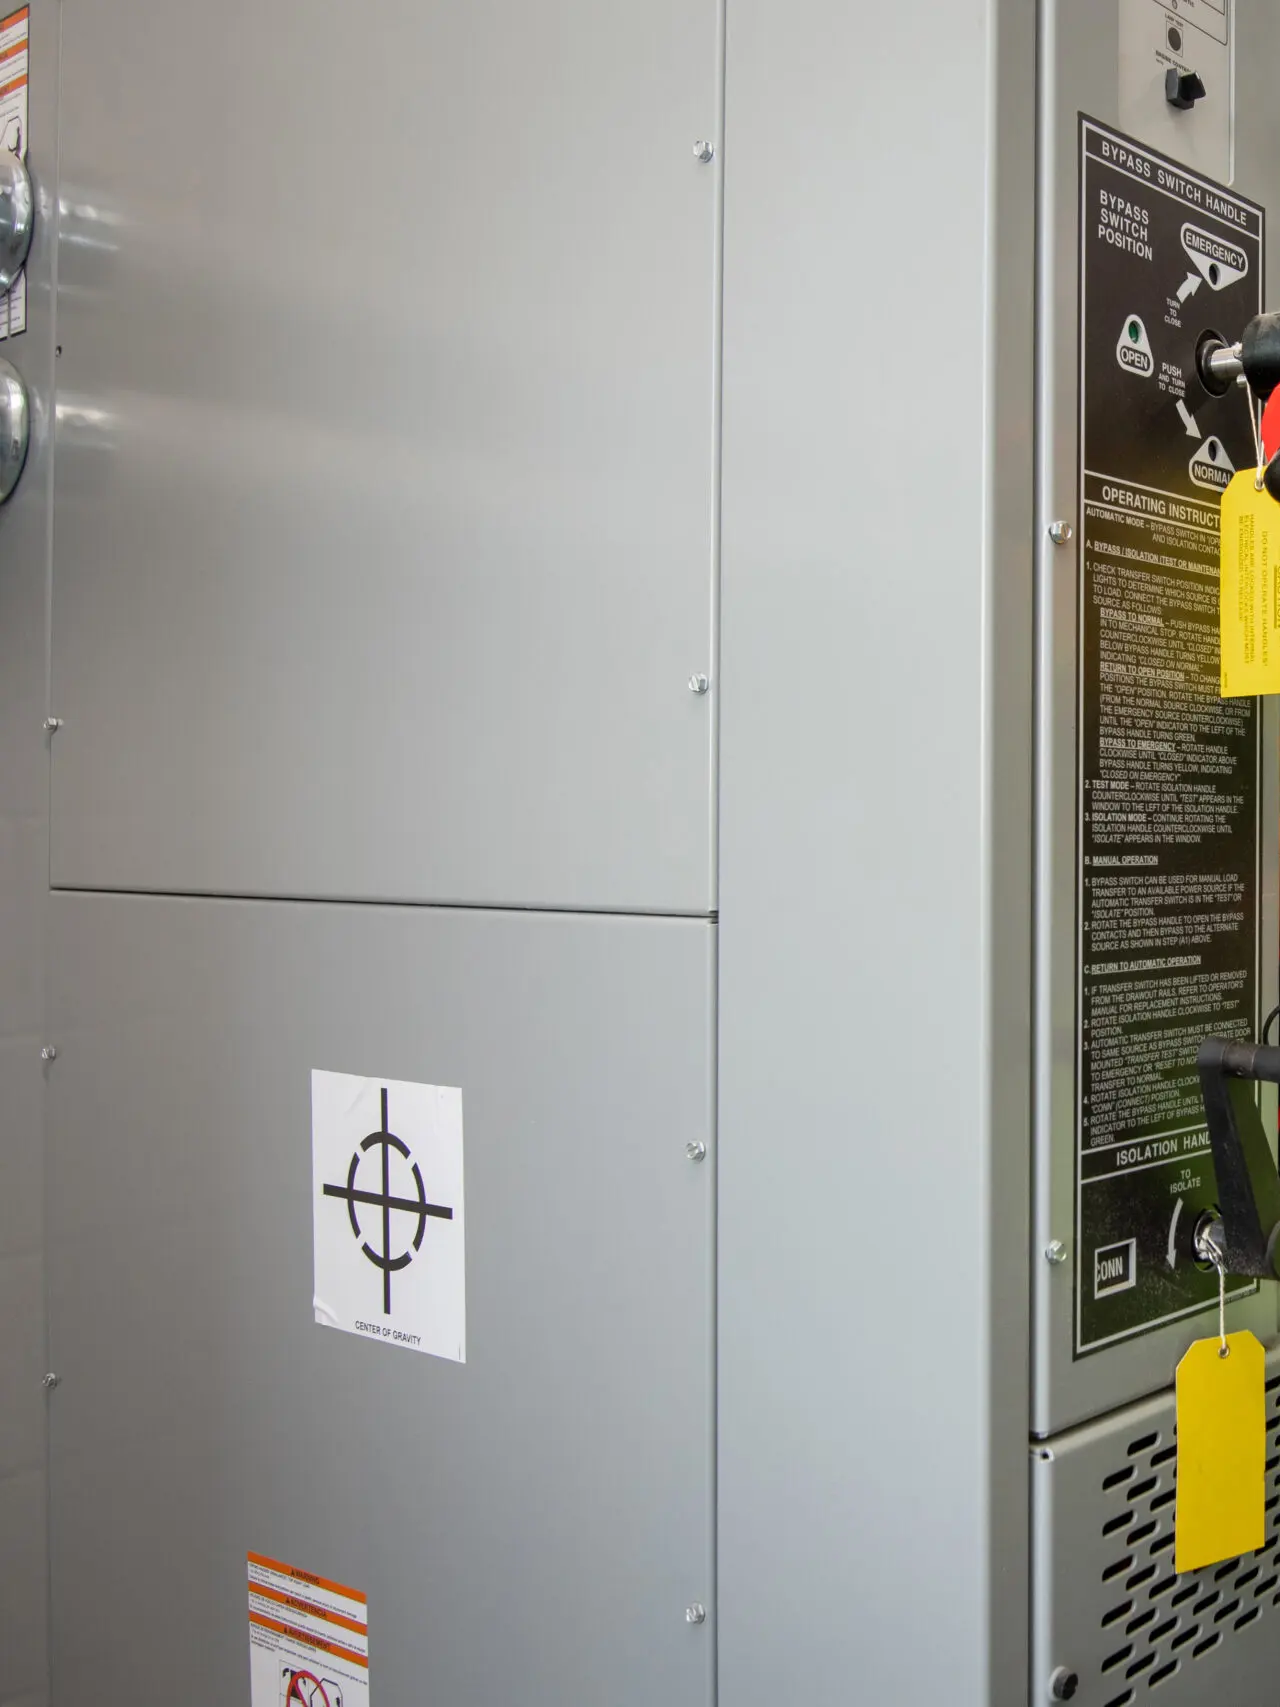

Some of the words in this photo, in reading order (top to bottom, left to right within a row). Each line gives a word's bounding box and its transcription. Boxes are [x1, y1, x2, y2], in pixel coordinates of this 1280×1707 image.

[1102, 140, 1150, 178] BYPASS
[1157, 168, 1200, 203] SWITCH
[1205, 193, 1246, 226] HANDLE
[1100, 188, 1148, 225] BYPASS
[1100, 207, 1147, 241] SWITCH
[1098, 223, 1152, 261] POSITION
[1185, 230, 1243, 269] EMERGENCY
[1166, 297, 1180, 310] TURN
[1169, 307, 1176, 317] TO
[1164, 314, 1181, 328] CLOSE
[1121, 346, 1147, 370] OPEN
[1162, 362, 1181, 378] PUSH
[1158, 372, 1170, 383] AND
[1172, 377, 1185, 389] TURN
[1158, 381, 1165, 391] TO
[1168, 385, 1185, 397] CLOSE
[1102, 485, 1165, 515] OPERATING
[1086, 506, 1123, 524] AUTOMATIC
[1126, 516, 1143, 528] MODE
[1150, 522, 1173, 535] BYPASS
[1176, 527, 1198, 541] SWITCH
[1200, 533, 1205, 542] IN
[1095, 541, 1120, 554] BYPASS
[1126, 547, 1157, 562] ISOLATION
[1178, 558, 1186, 568] OR
[1093, 562, 1114, 575] CHECK
[1118, 567, 1149, 582] TRANSFER
[1152, 573, 1174, 586] SWITCH
[1176, 578, 1203, 592] POSITION
[1100, 661, 1125, 673] RETURN
[1128, 665, 1135, 674] TO
[1138, 666, 1154, 676] OPEN
[1157, 668, 1184, 679] POSITION
[1099, 737, 1125, 747] BYPASS
[1127, 739, 1135, 747] TO
[1137, 739, 1174, 750] EMERGENCY
[1093, 780, 1108, 789] TEST
[1110, 781, 1128, 790] MODE
[1135, 781, 1159, 791] ROTATE
[1162, 782, 1191, 792] ISOLATION
[1193, 783, 1215, 793] HANDLE
[1092, 813, 1126, 822] ISOLATION
[1128, 814, 1146, 822] MODE
[1152, 814, 1182, 822] CONTINUE
[1185, 814, 1213, 822] ROTATING
[1215, 814, 1225, 822] THE
[1093, 855, 1119, 864] MANUAL
[1122, 855, 1157, 864] OPERATION
[1092, 877, 1117, 888] BYPASS
[1119, 876, 1143, 886] SWITCH
[1145, 876, 1157, 885] CAN
[1159, 875, 1166, 884] BE
[1169, 875, 1183, 884] USED
[1186, 874, 1197, 883] FOR
[1199, 873, 1220, 883] MANUAL
[1223, 873, 1237, 882] LOAD
[1092, 962, 1117, 974] RETURN
[1120, 961, 1127, 971] TO
[1130, 958, 1164, 970] AUTOMATIC
[1167, 954, 1200, 966] OPERATION
[1091, 1036, 1127, 1051] AUTOMATIC
[1130, 1030, 1161, 1045] TRANSFER
[1164, 1026, 1186, 1039] SWITCH
[1188, 1024, 1202, 1035] MUST
[1205, 1022, 1211, 1032] BE
[1214, 1017, 1247, 1031] CONNECTED
[1090, 1112, 1115, 1126] ROTATE
[1119, 1109, 1129, 1120] THE
[1132, 1103, 1155, 1117] BYPASS
[1157, 1098, 1180, 1112] HANDLE
[1183, 1094, 1198, 1106] UNTIL
[1116, 1137, 1177, 1167] ISOLATION
[1180, 1168, 1190, 1180] TO
[1170, 1177, 1200, 1194] ISOLATE
[355, 1320, 381, 1335] CENTER
[382, 1328, 391, 1337] OF
[392, 1330, 421, 1346] GRAVITY
